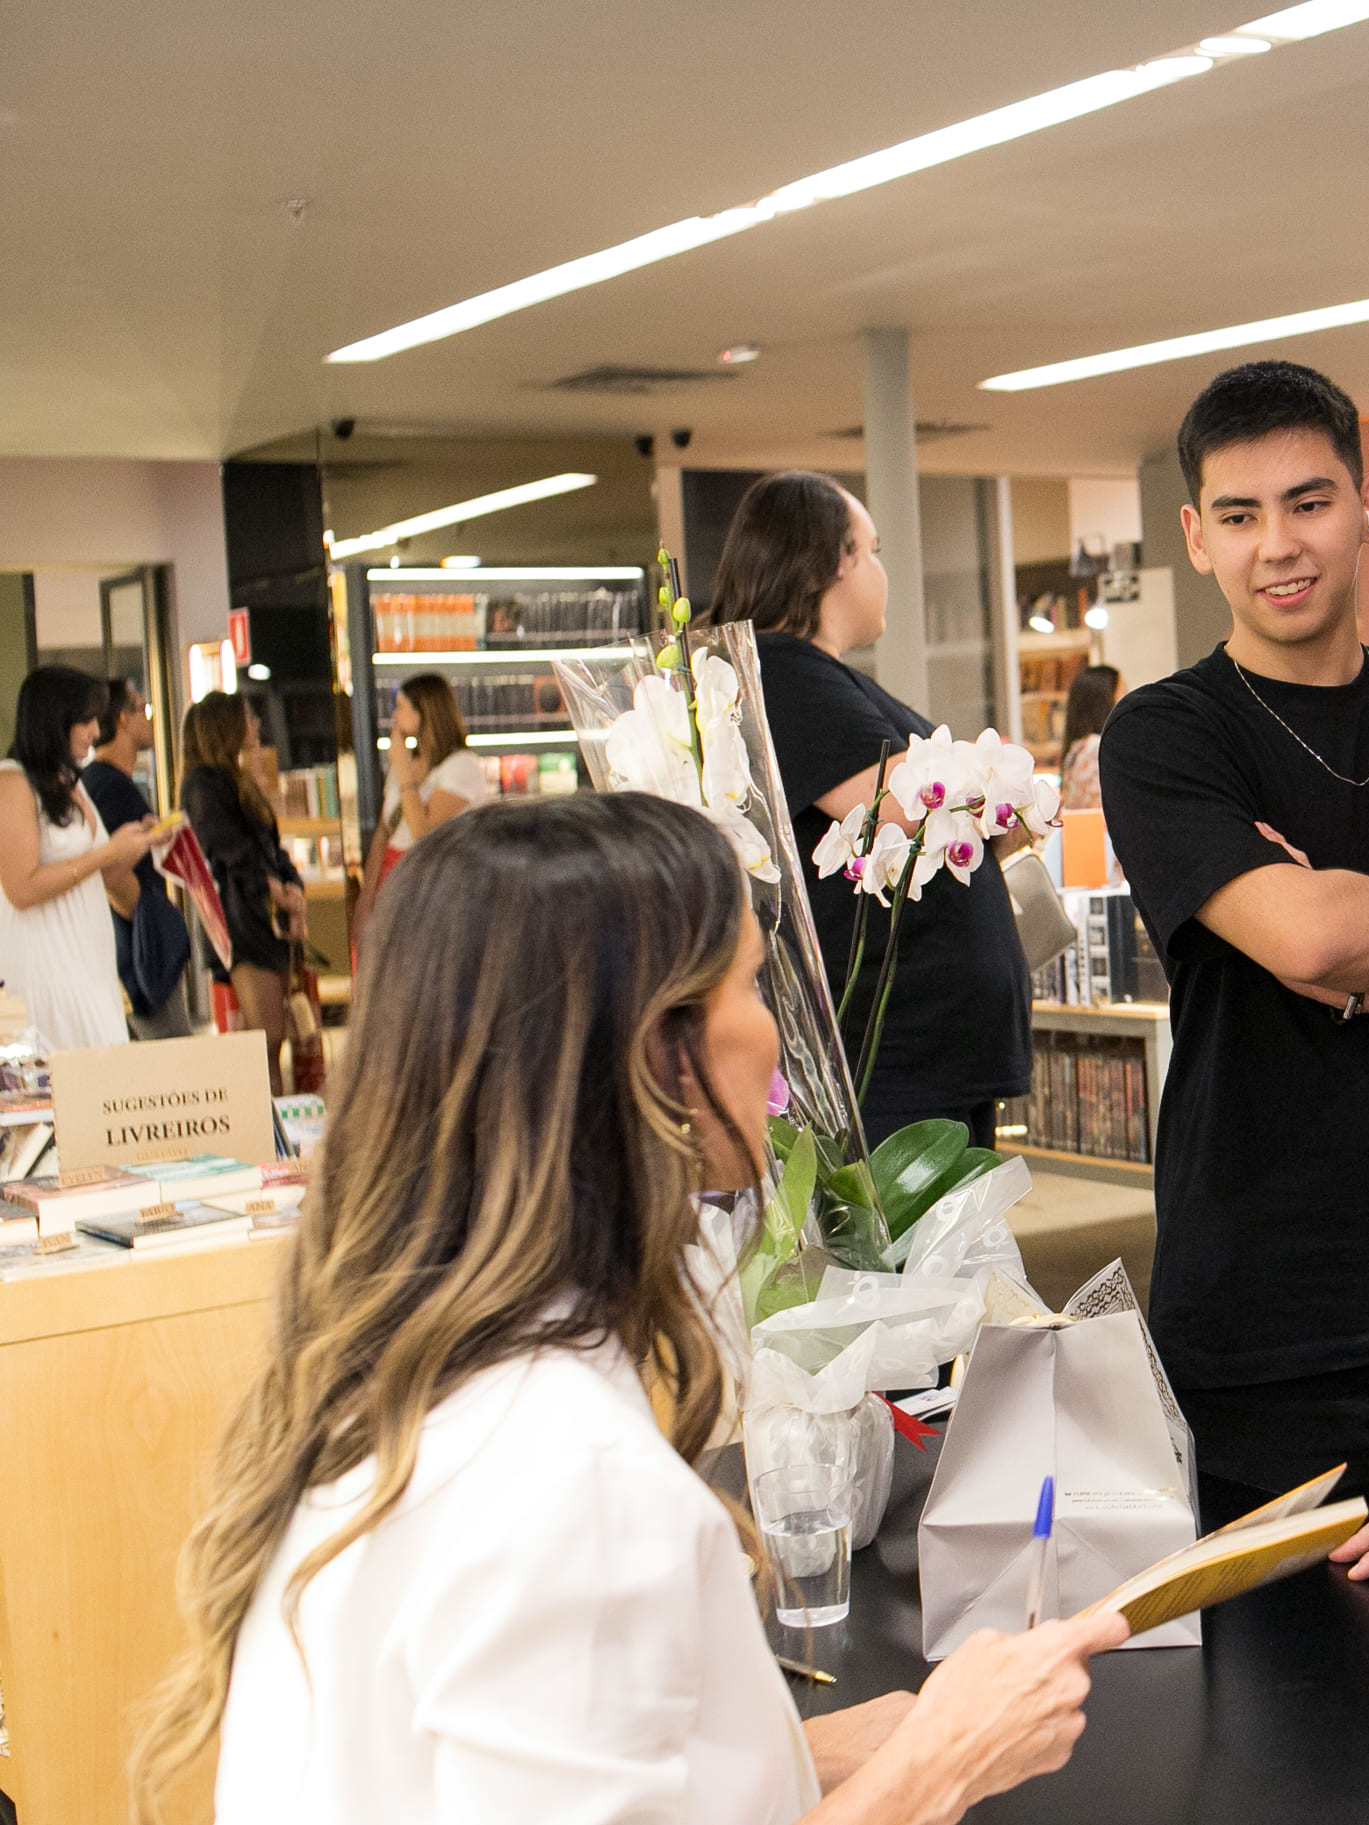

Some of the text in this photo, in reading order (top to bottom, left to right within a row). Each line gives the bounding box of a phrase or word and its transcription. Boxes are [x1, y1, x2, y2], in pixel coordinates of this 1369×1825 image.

[103, 1088, 228, 1115] SUGESTÕES DE
[106, 1115, 231, 1147] LIVREIROS
